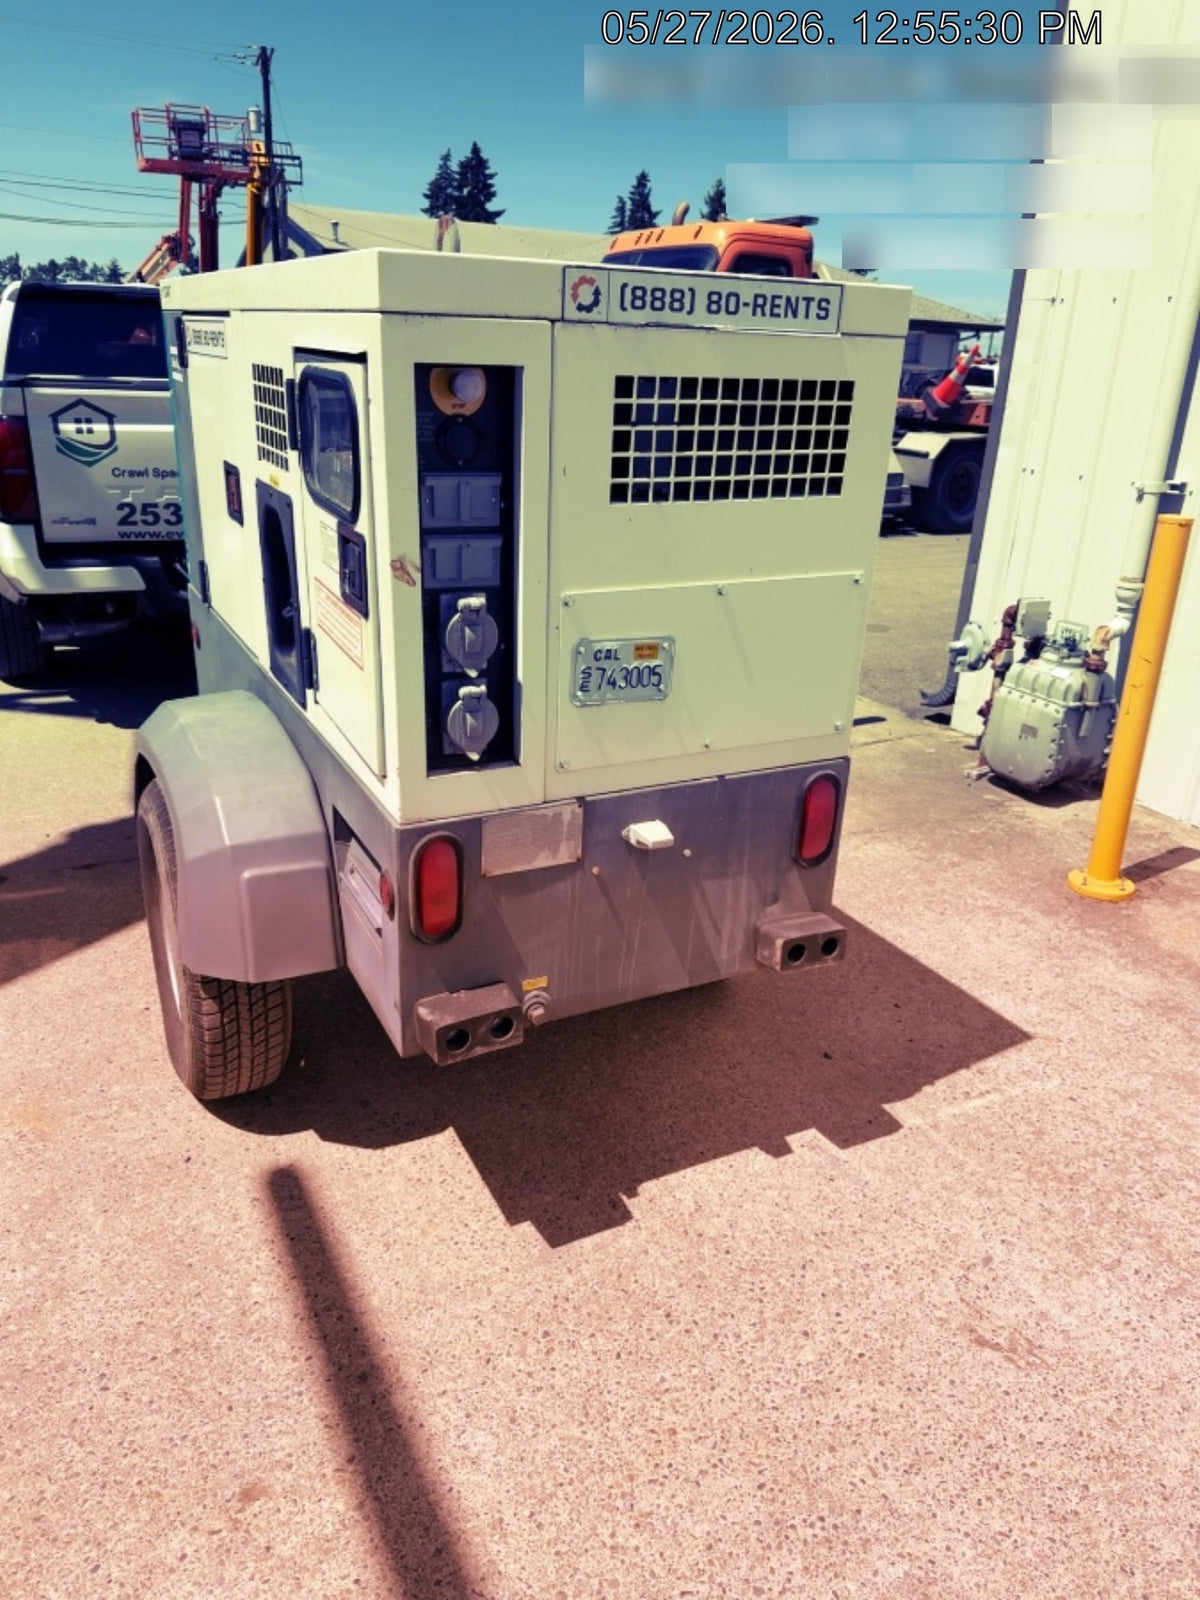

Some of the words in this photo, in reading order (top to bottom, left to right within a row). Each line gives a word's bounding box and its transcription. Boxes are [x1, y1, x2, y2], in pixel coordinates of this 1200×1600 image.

[620, 282, 696, 316] (888)
[706, 291, 832, 321] 80-RENTS
[111, 467, 149, 478] Crawl
[117, 503, 183, 526] 253
[593, 647, 621, 662] CAL
[596, 664, 663, 691] 743005
